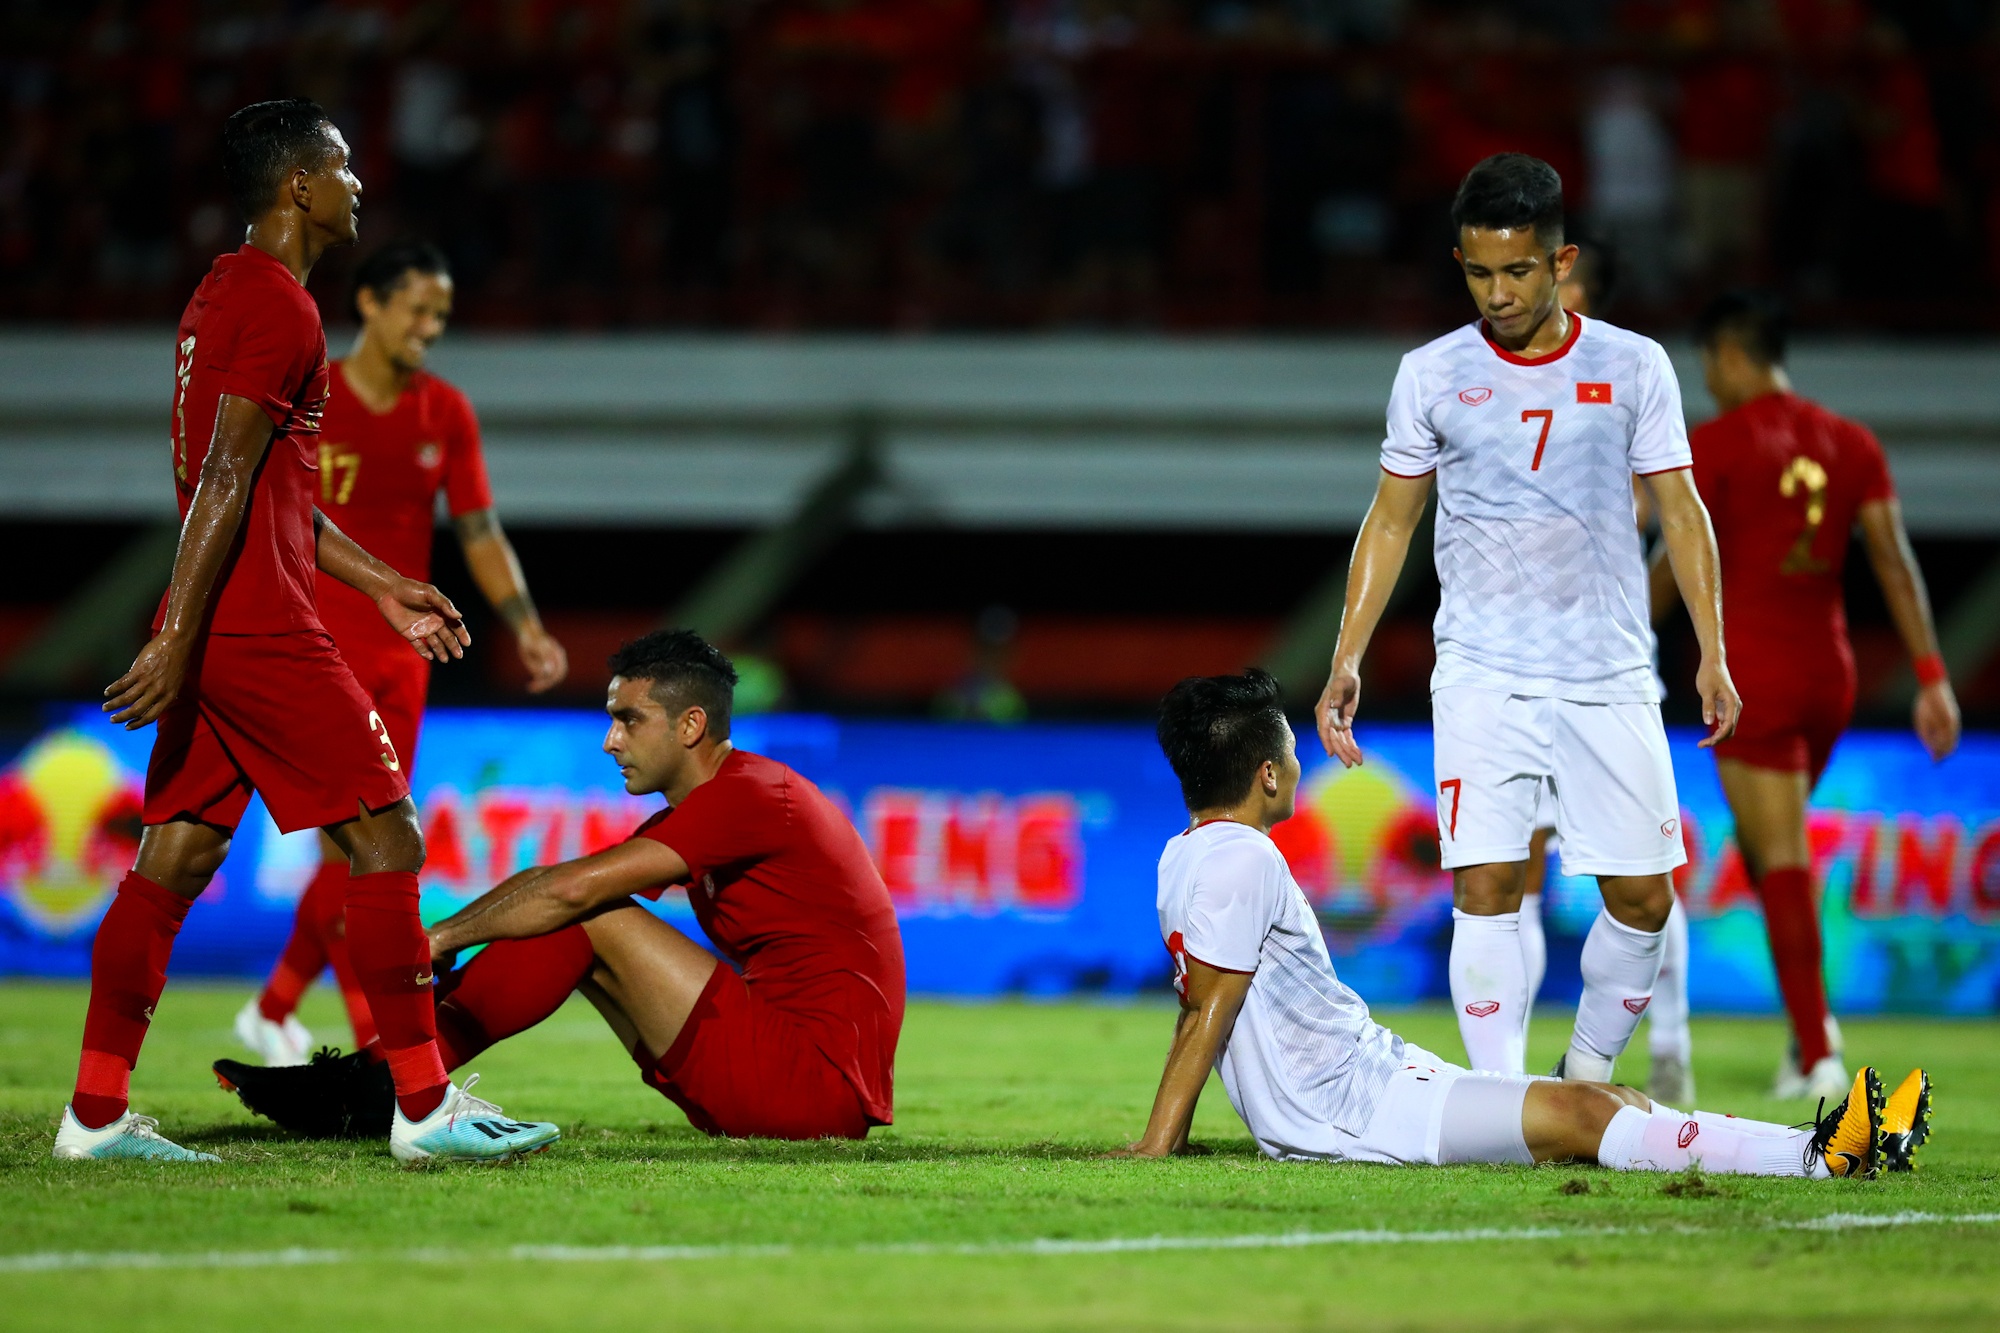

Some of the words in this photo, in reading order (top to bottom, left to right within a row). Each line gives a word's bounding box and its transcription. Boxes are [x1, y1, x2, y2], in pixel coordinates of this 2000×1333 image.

[1521, 409, 1553, 471] 7
[318, 442, 361, 505] 17
[1779, 455, 1830, 576] 2
[368, 710, 399, 772] 3
[1440, 778, 1461, 842] 7
